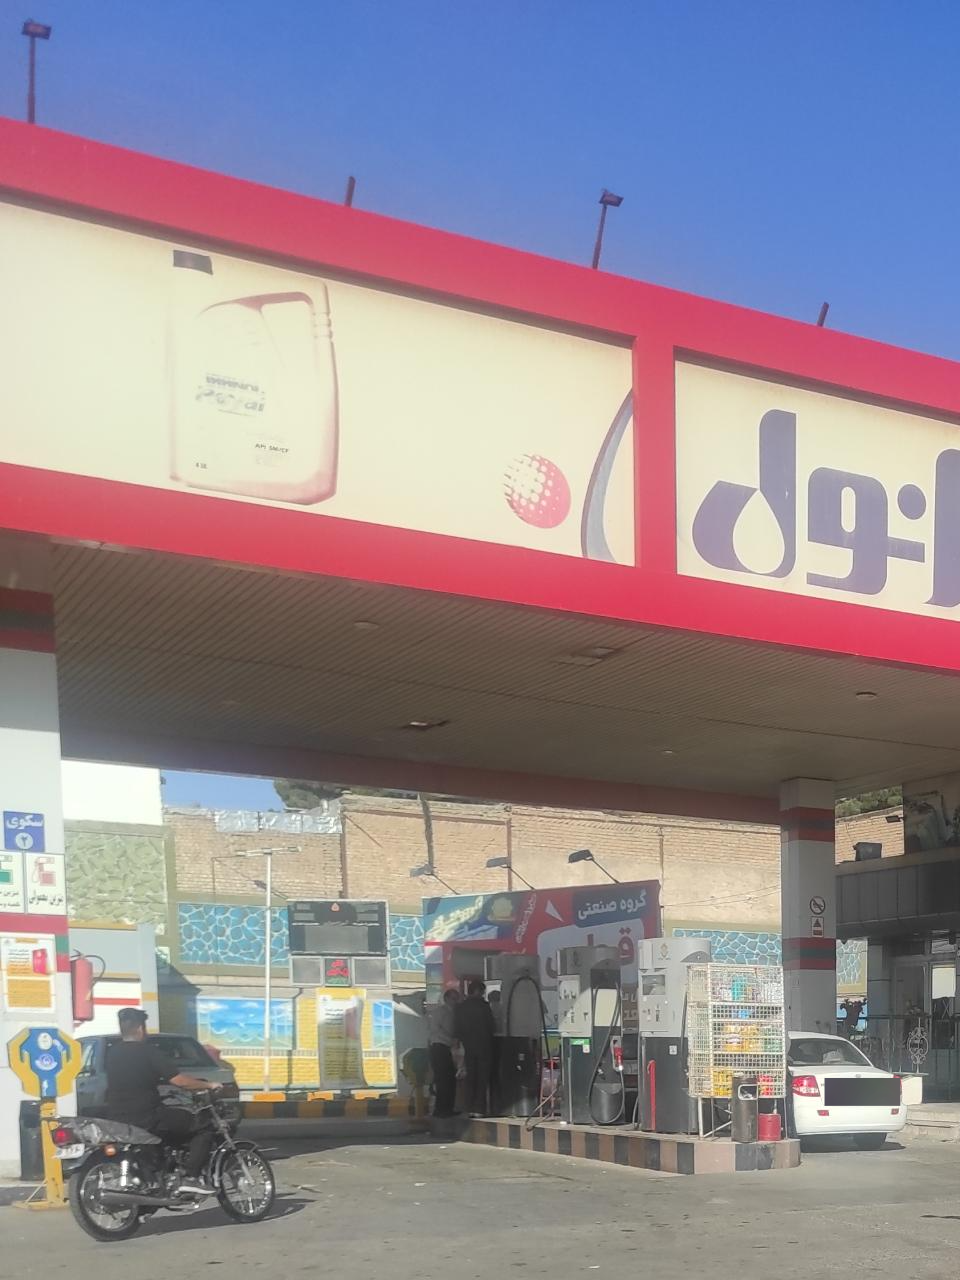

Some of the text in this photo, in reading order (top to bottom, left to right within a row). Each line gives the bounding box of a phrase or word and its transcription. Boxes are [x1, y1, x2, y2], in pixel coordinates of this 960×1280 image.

[7, 814, 43, 829] سکوی
[578, 889, 647, 920] گروه صنعتی
